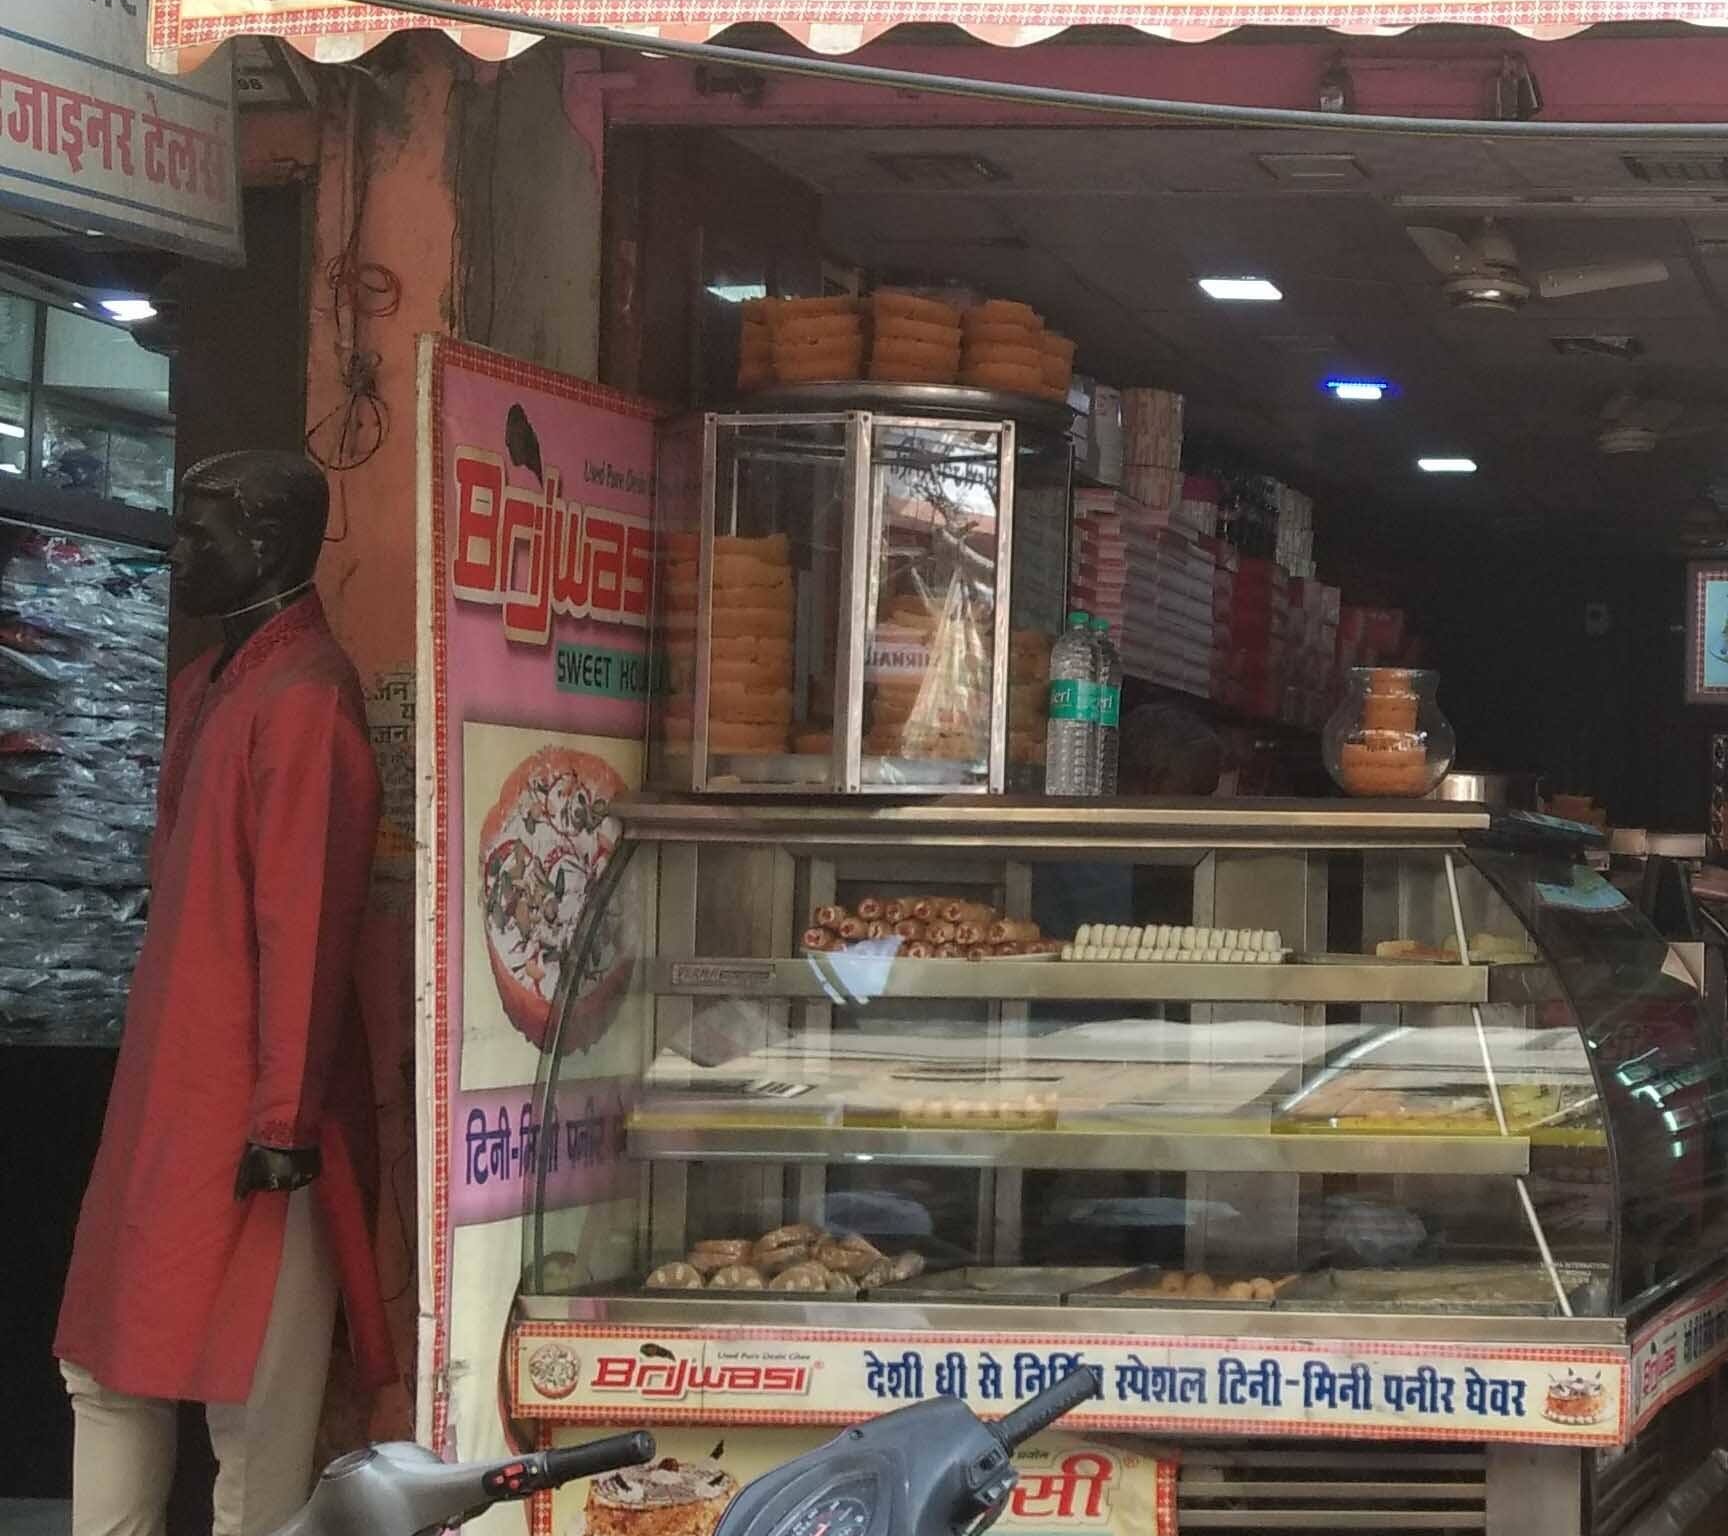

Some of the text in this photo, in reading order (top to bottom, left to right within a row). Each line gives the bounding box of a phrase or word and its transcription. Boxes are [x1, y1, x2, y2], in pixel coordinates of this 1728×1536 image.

[0, 69, 136, 176] जाइनर
[453, 456, 655, 631] Brijwas
[557, 650, 612, 688] SWEET
[590, 1357, 806, 1396] Brijwasi
[863, 1350, 924, 1398] देशी
[978, 1351, 1004, 1399] से
[1114, 1353, 1208, 1405] स्पेशल
[1217, 1358, 1373, 1412] टिनी-मिनी
[1383, 1366, 1455, 1416] पनीर
[1465, 1368, 1528, 1418] घेवर
